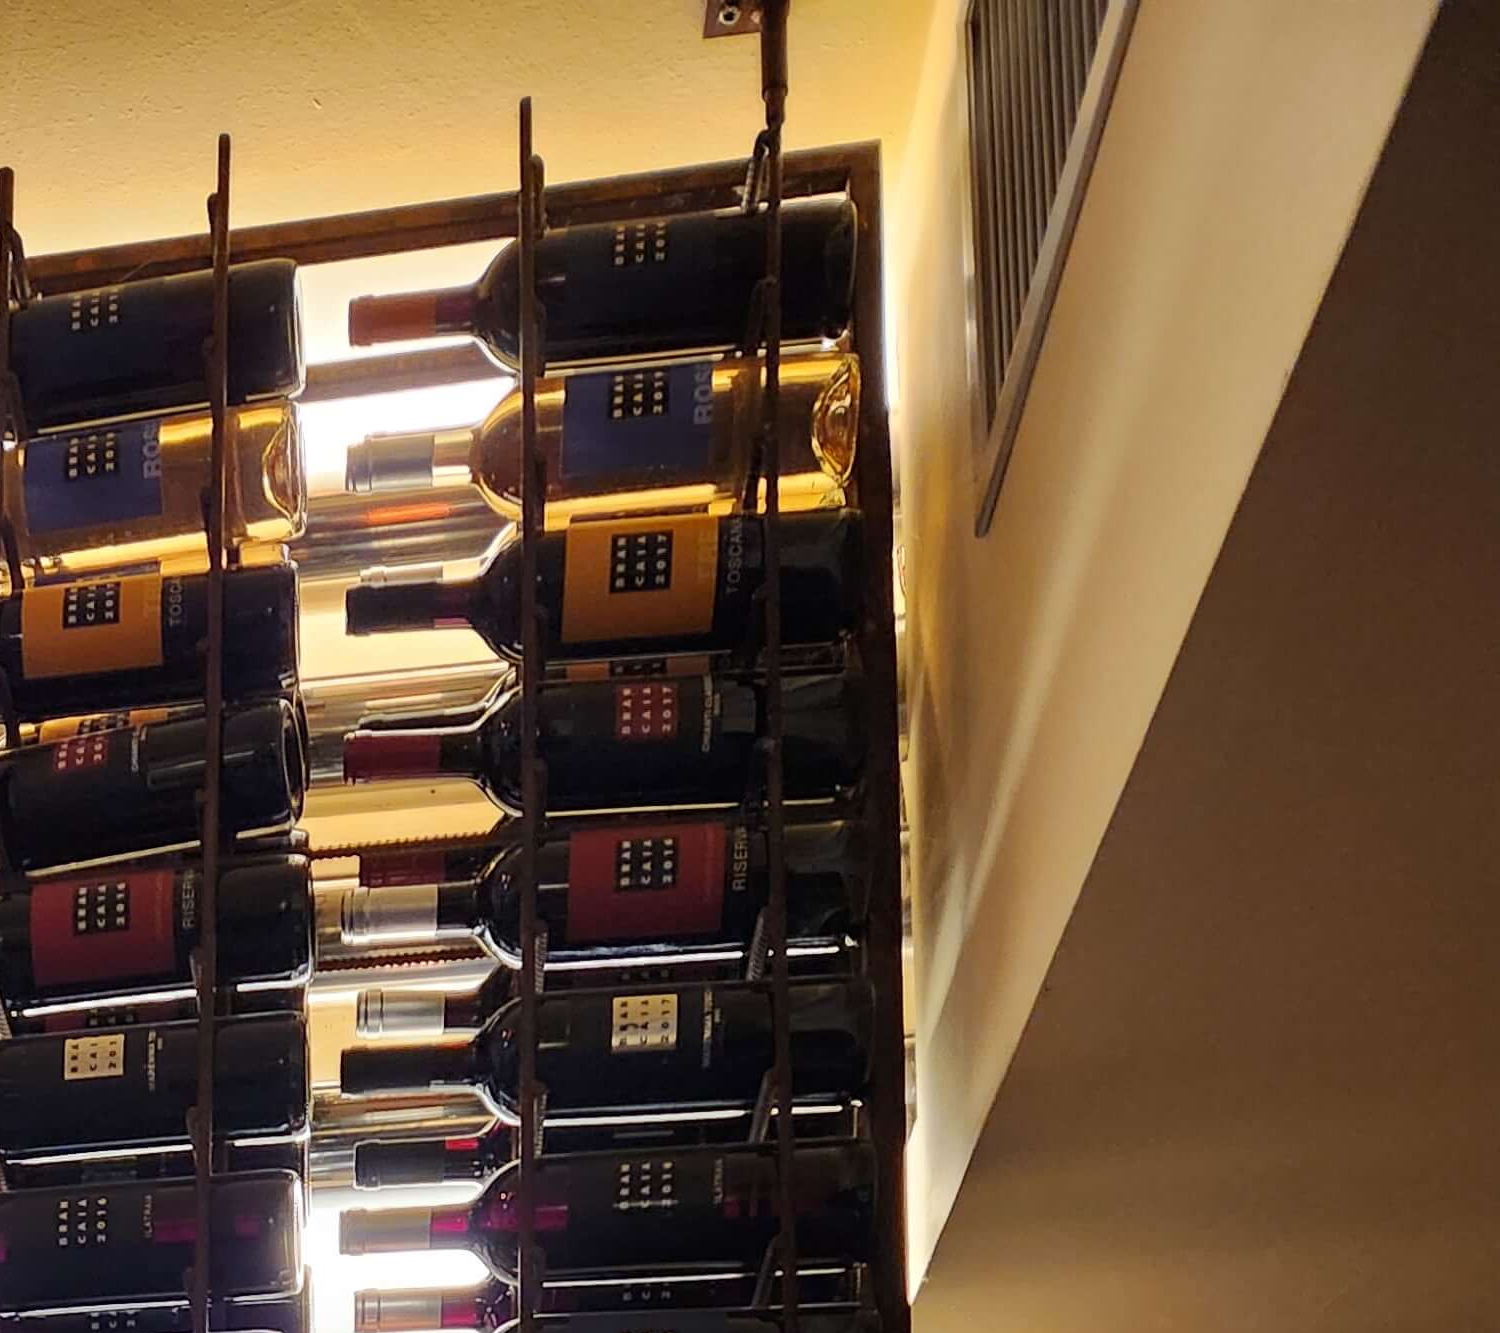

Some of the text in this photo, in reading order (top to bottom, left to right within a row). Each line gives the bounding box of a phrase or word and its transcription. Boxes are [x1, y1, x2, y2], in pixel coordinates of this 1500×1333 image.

[142, 424, 161, 479] ROS
[615, 537, 626, 588] BRAN
[636, 536, 646, 586] CAIA
[655, 534, 667, 584] 2017
[621, 687, 631, 735] BRAN
[641, 686, 651, 733] CAIA
[661, 687, 672, 731] 2017
[621, 840, 631, 887] BRAN
[641, 839, 652, 884] CAIA
[77, 887, 88, 931] BRAN
[96, 884, 107, 928] CAIA
[619, 1162, 631, 1210] BRAN
[640, 1161, 651, 1207] CAIA
[57, 1200, 69, 1247] BRAN
[76, 1199, 88, 1245] CAIA
[95, 1197, 107, 1243] 2016
